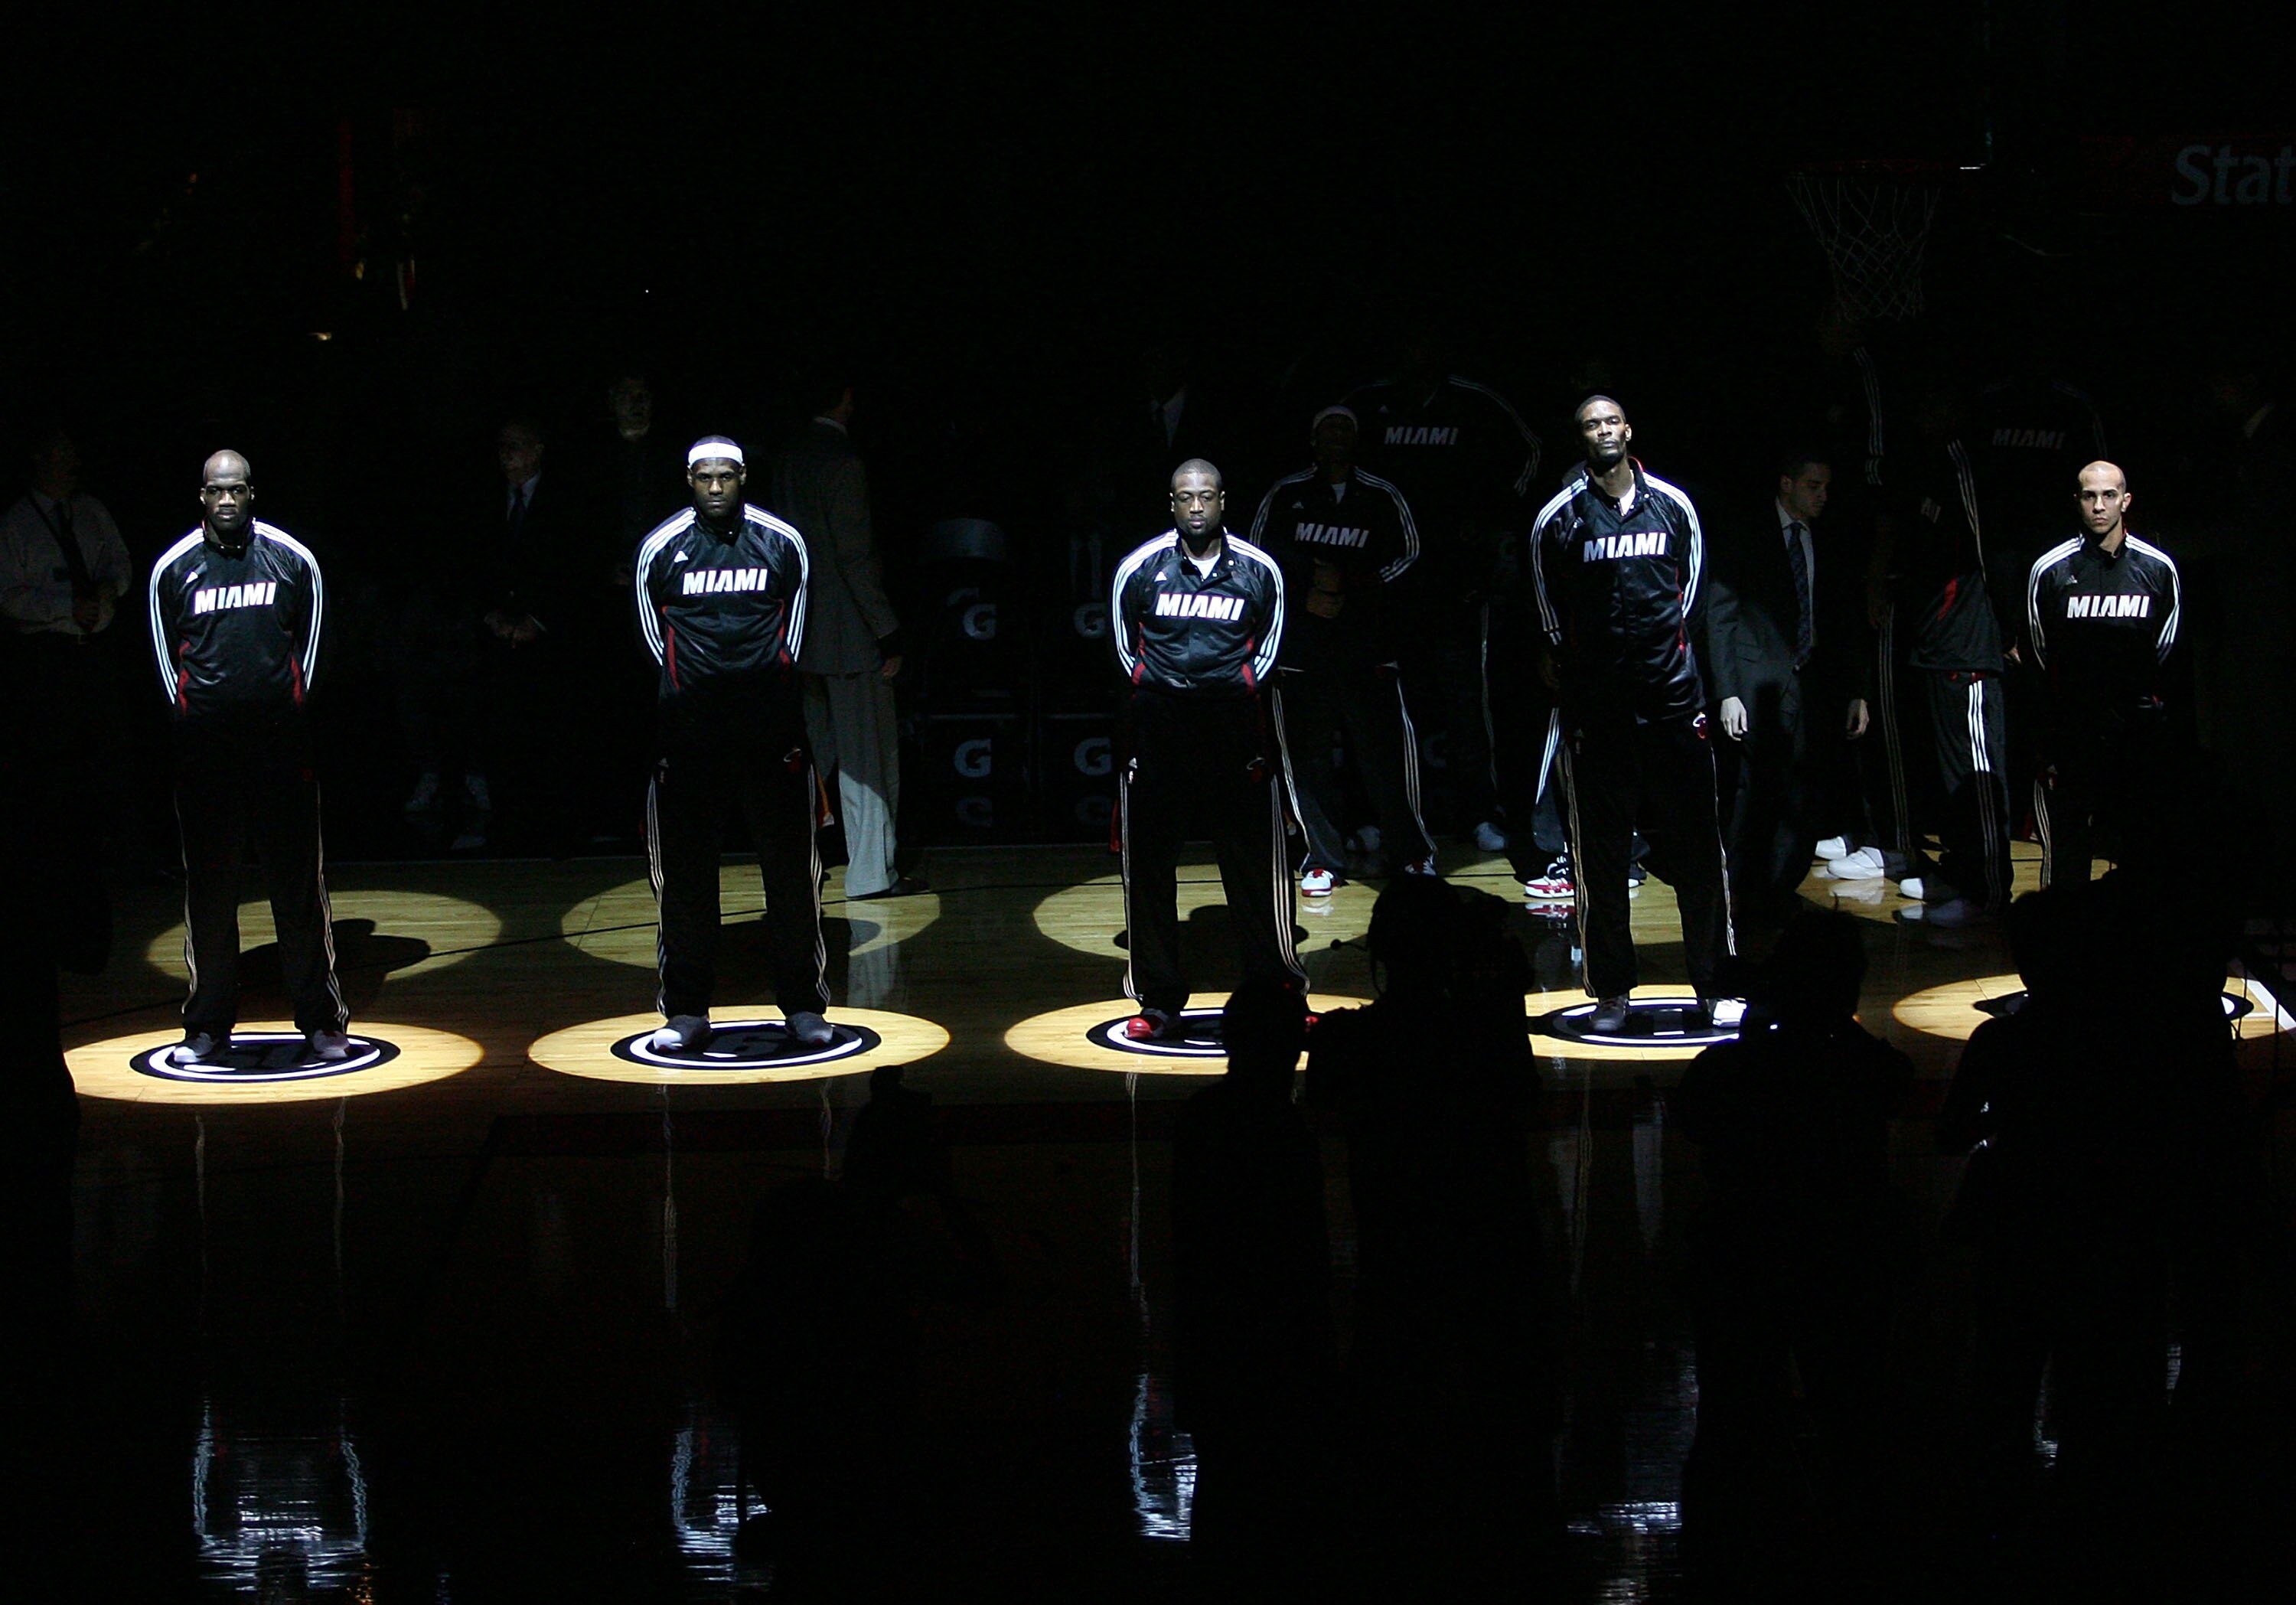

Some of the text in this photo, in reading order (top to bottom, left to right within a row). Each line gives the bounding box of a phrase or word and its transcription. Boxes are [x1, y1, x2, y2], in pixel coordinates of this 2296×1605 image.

[1384, 426, 1459, 445] MIAMI
[1991, 428, 2066, 450] MIAMI
[1293, 521, 1371, 549] MIAMI
[1583, 532, 1666, 563] MIAMI
[682, 568, 768, 595] MIAMI
[194, 582, 276, 615] MIAMI
[1156, 592, 1244, 621] MIAMI
[2066, 594, 2150, 618] MIAMI
[963, 602, 997, 641] G
[954, 738, 992, 778] G
[1074, 736, 1112, 776] G
